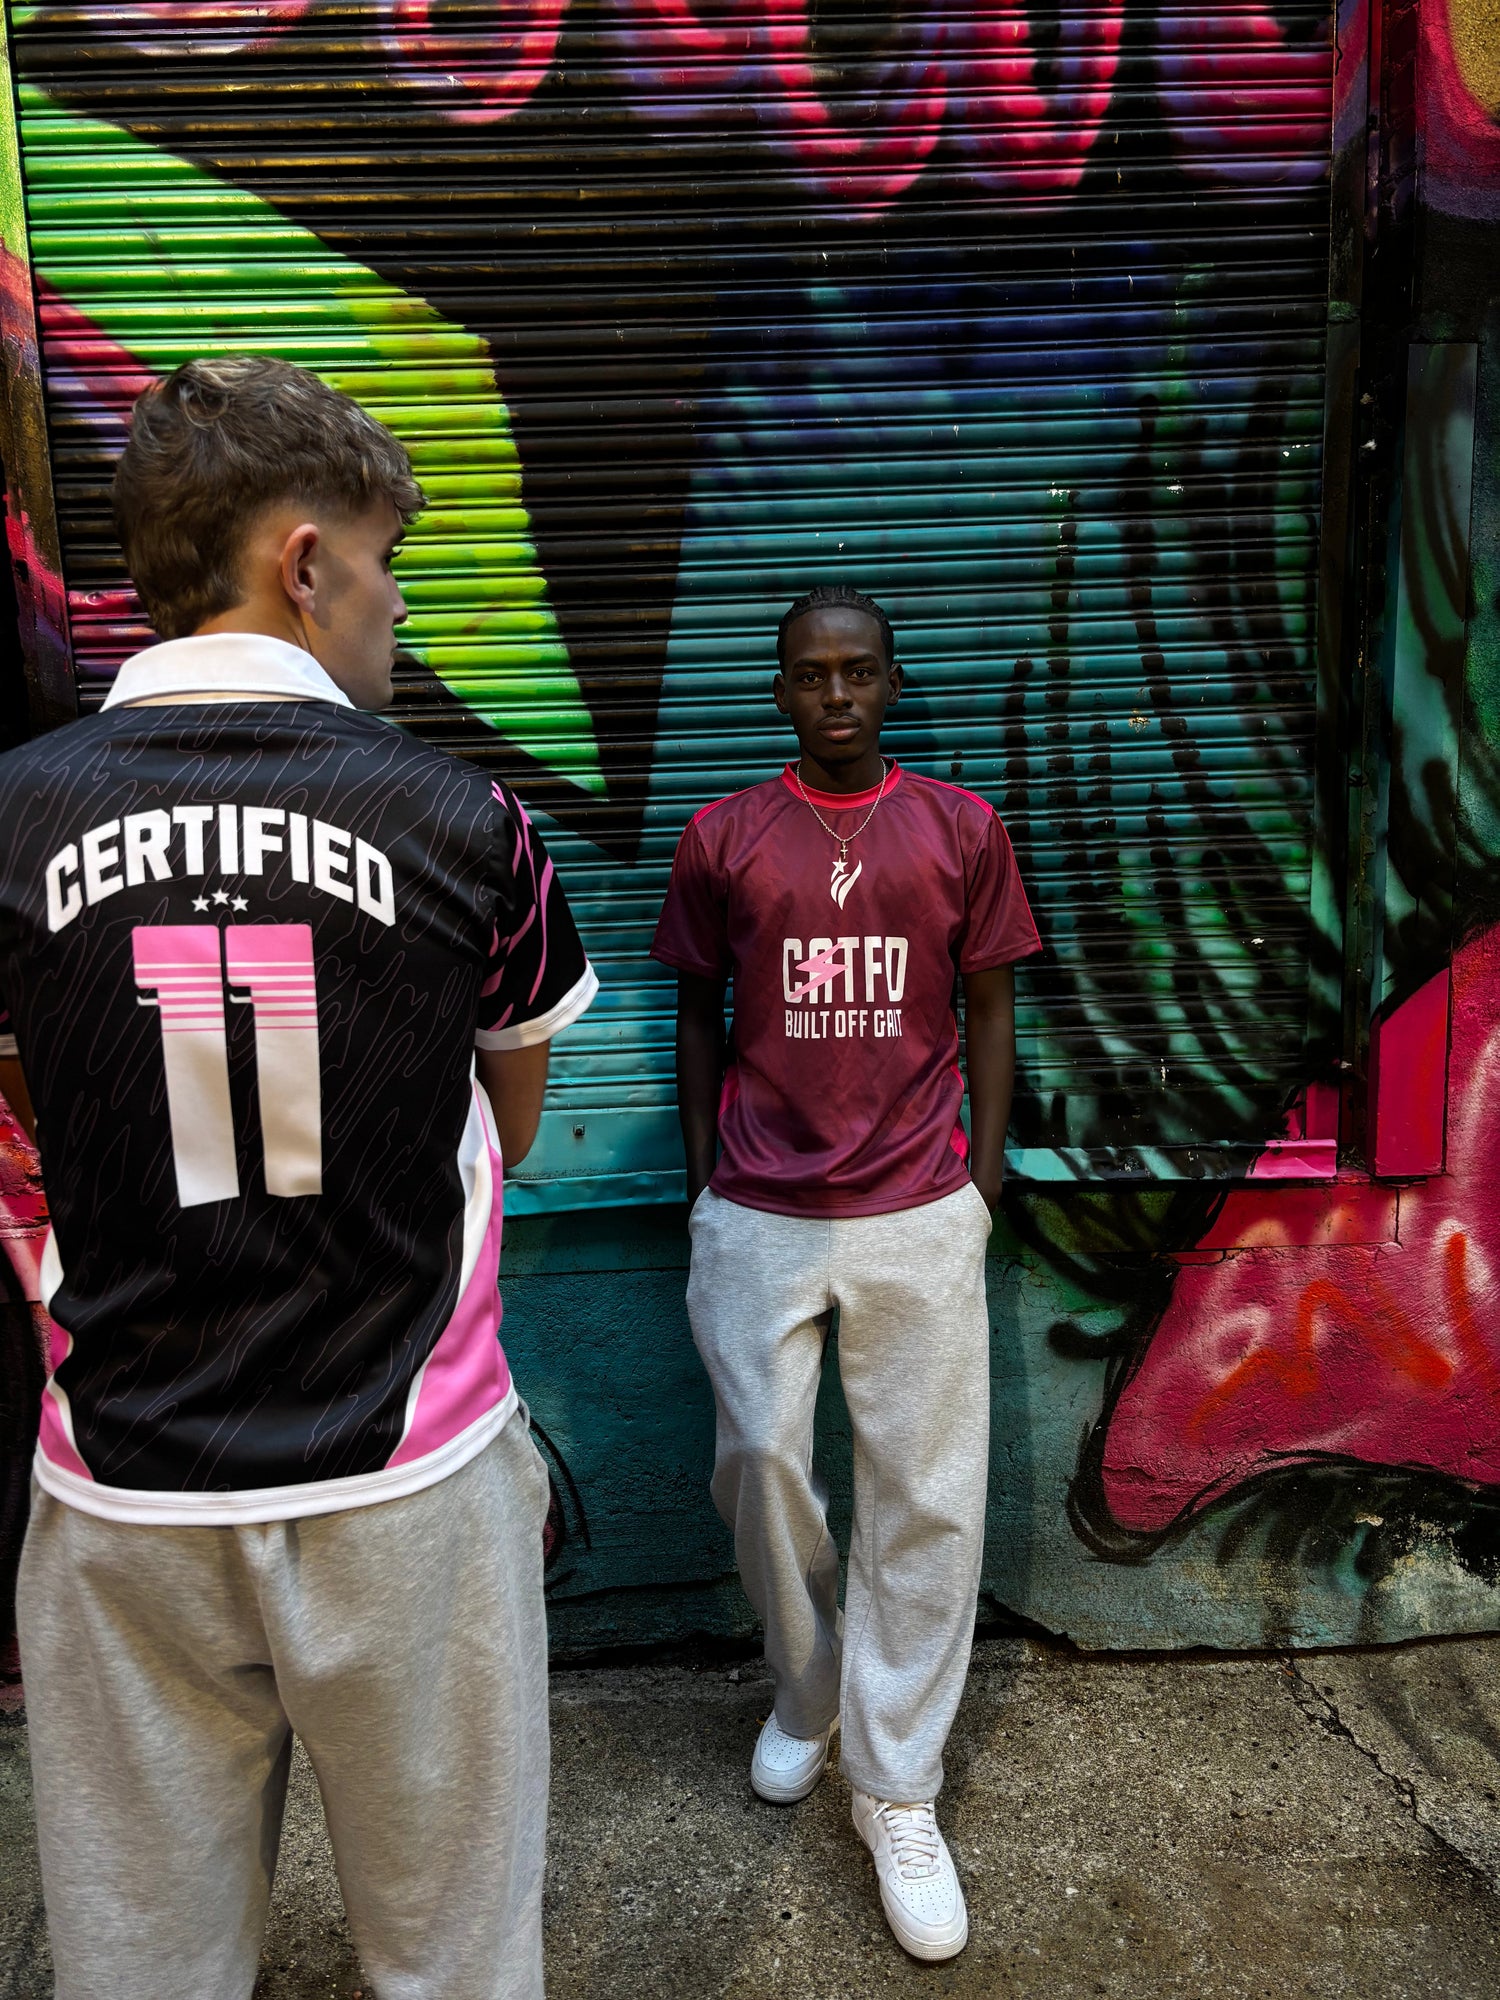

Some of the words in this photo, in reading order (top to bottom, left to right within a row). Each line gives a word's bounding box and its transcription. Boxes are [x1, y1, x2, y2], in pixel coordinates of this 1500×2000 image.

[45, 804, 396, 933] CERTIFIED
[132, 924, 323, 1208] 11
[785, 1009, 830, 1039] BUILT
[835, 1009, 868, 1038] OFF
